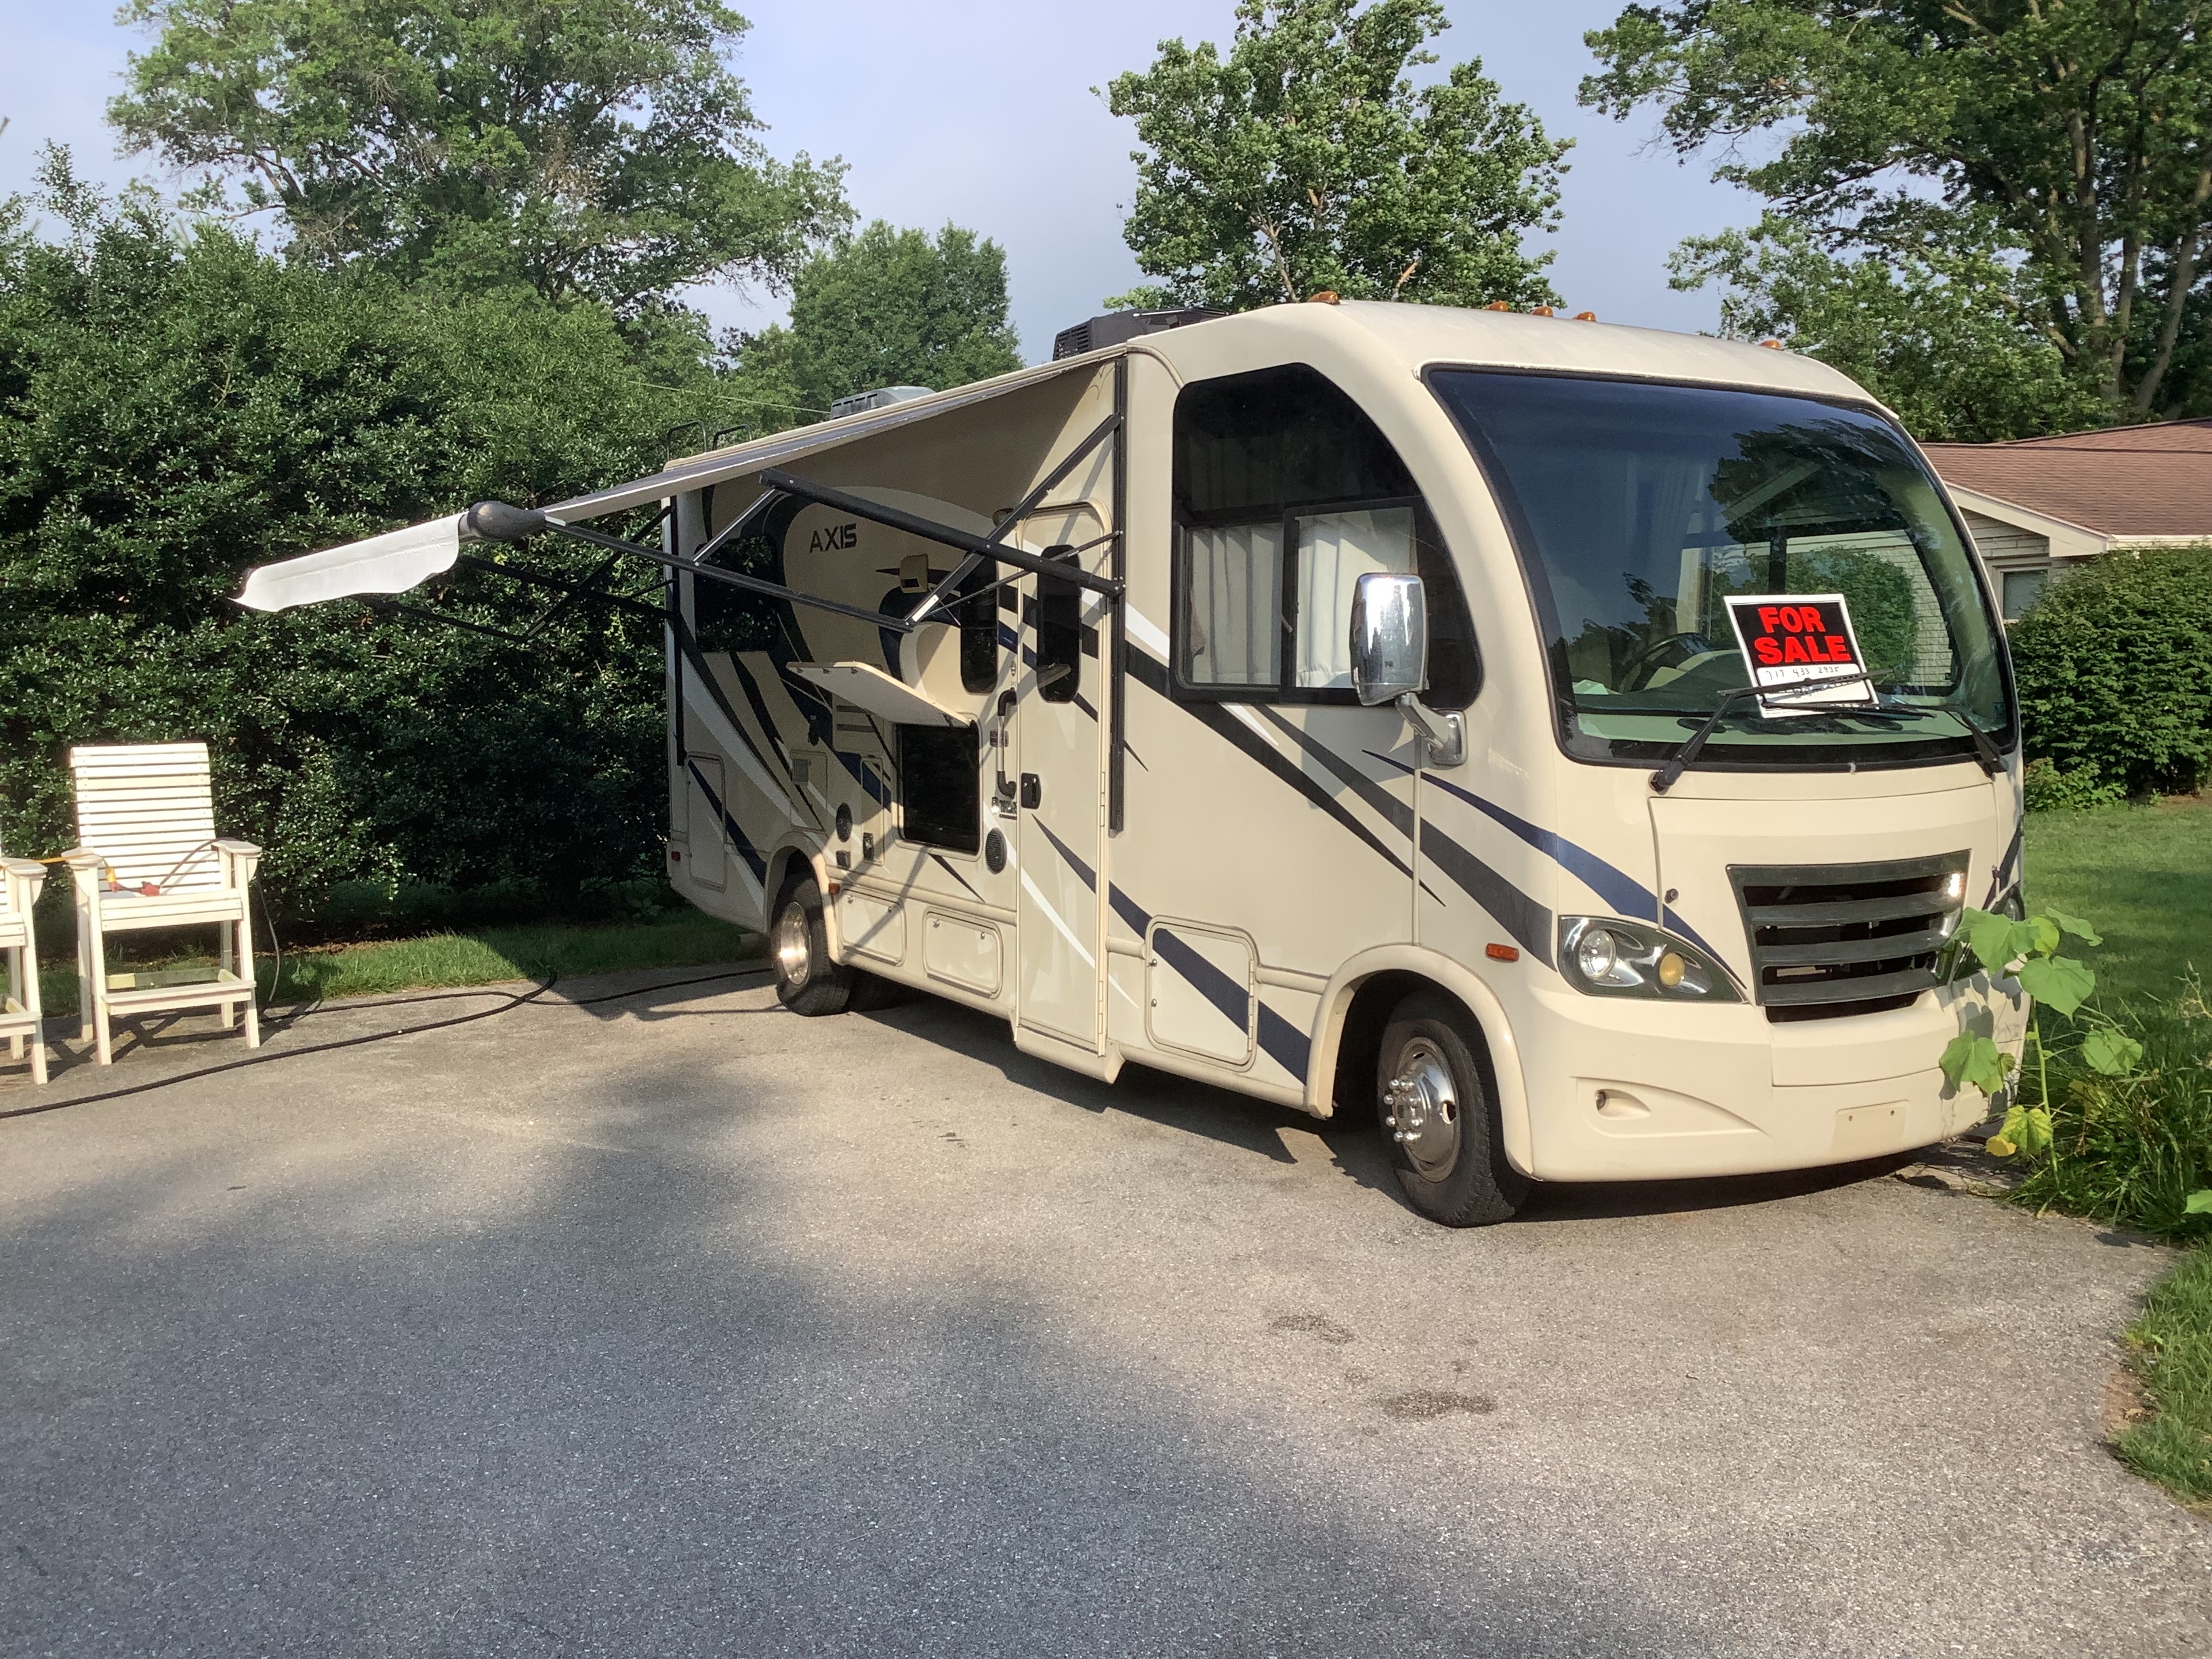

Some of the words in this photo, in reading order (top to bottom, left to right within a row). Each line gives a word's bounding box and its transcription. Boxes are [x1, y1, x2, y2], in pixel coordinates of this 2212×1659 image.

[809, 523, 857, 553] AXIS
[1757, 607, 1826, 634] FOR
[1754, 635, 1851, 664] SALE
[1765, 670, 1784, 680] 717
[1793, 668, 1810, 677] 433
